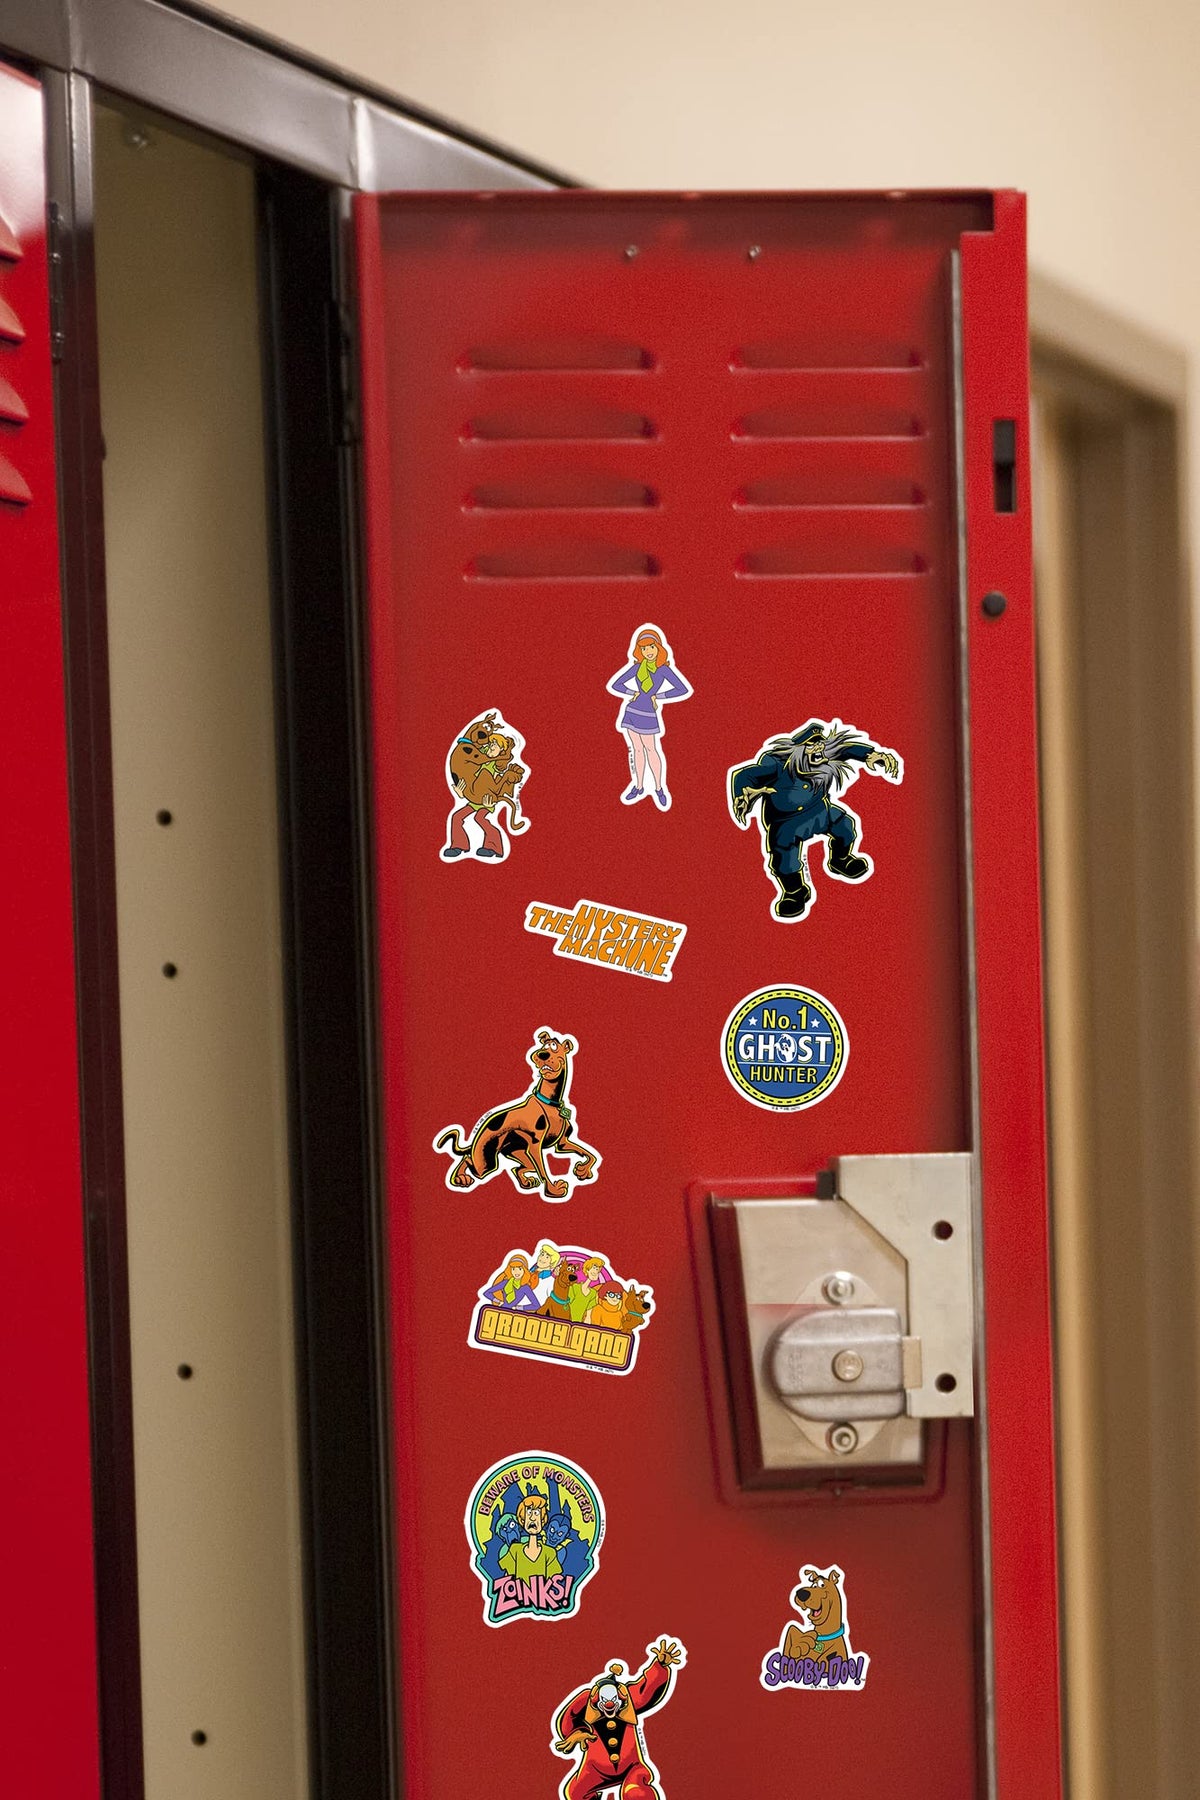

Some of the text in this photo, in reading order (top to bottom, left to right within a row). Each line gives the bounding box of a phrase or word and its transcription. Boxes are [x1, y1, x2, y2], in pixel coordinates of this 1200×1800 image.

[528, 906, 574, 936] THE
[567, 904, 683, 942] MYSTERY
[558, 935, 677, 977] MACHINE
[762, 1005, 808, 1030] No.1
[738, 1033, 832, 1064] GHOST
[750, 1065, 818, 1084] HUNTER
[478, 1466, 595, 1524] BEWARE OF MONSTERS
[492, 1574, 574, 1617] ZOINKS!
